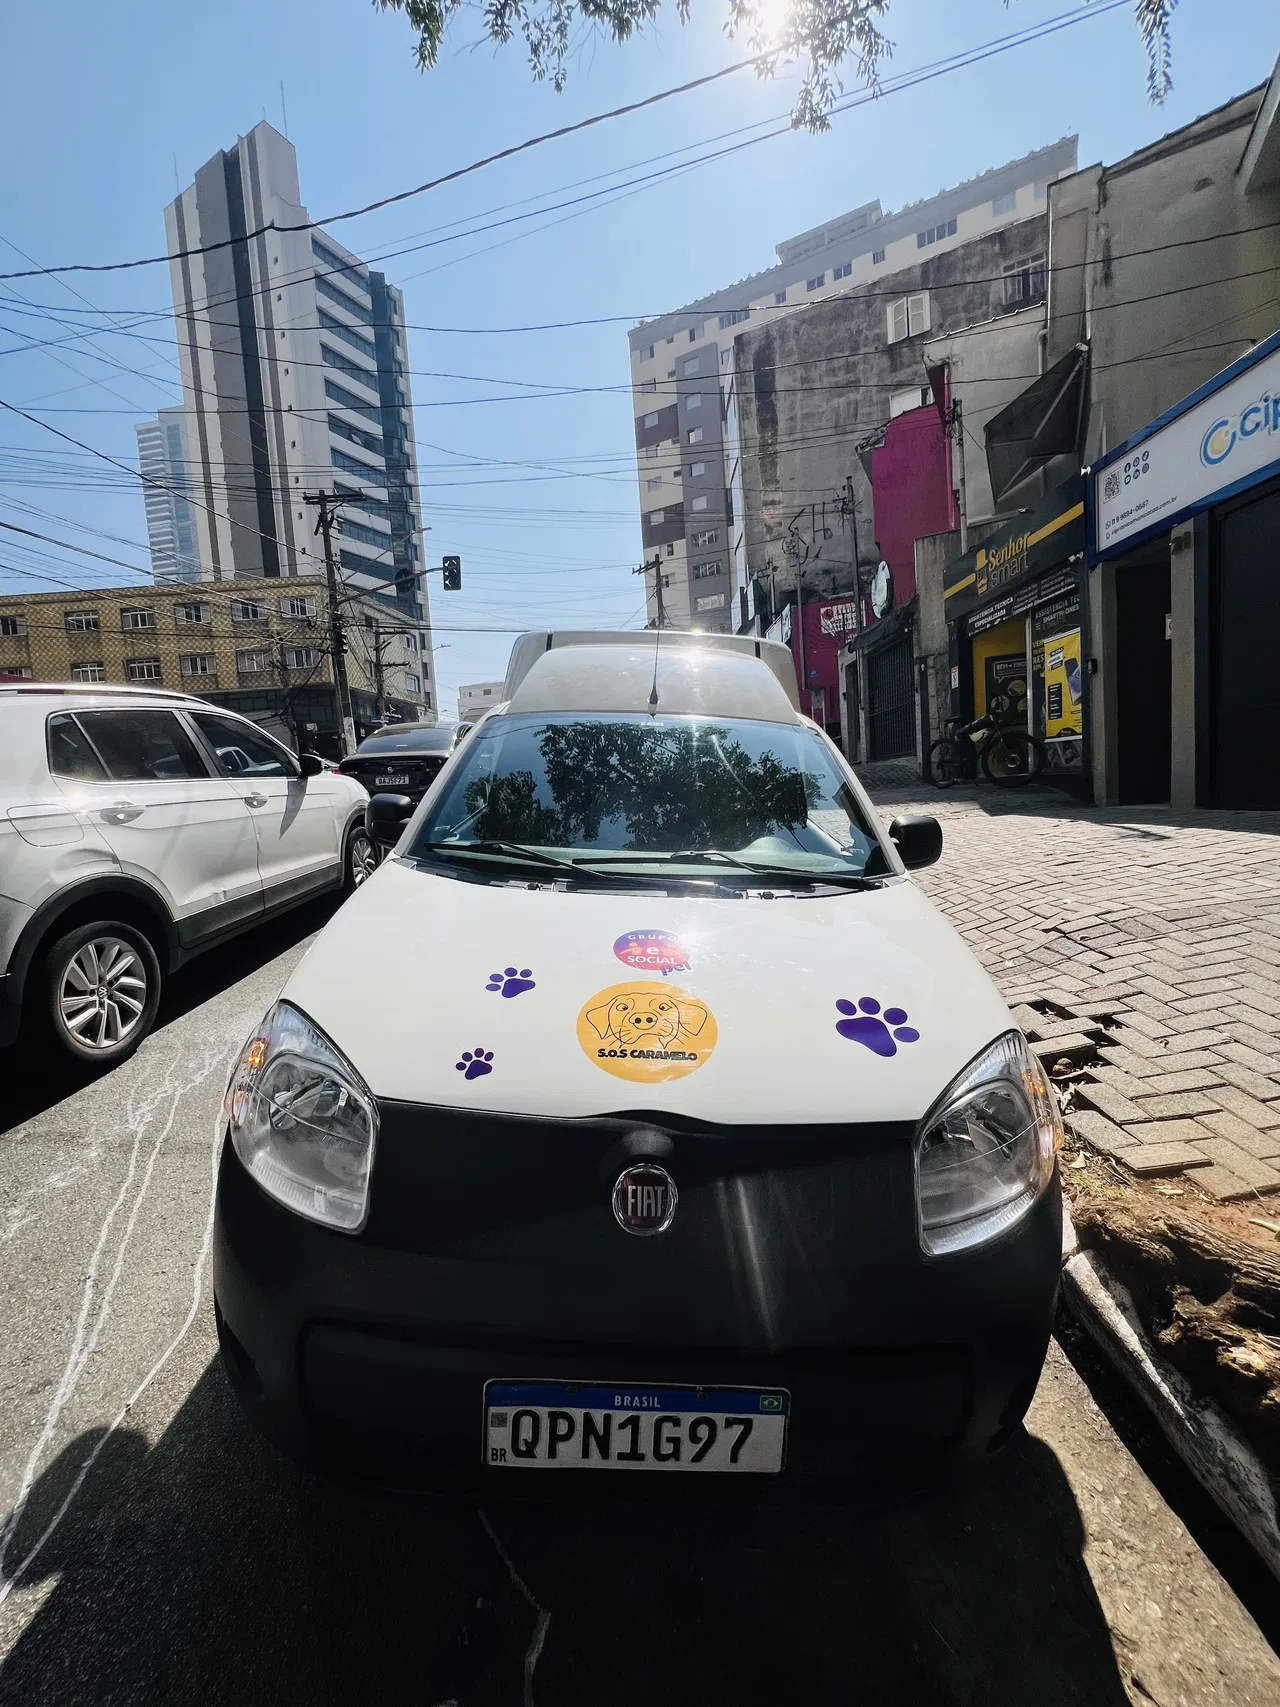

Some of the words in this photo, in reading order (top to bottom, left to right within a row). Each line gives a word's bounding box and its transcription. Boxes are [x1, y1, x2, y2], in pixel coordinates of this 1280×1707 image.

[988, 532, 1030, 571] Senhor
[991, 552, 1029, 588] smart
[627, 934, 677, 942] GRUPO
[627, 956, 679, 965] SOCIAL
[597, 1048, 628, 1059] S.O.S
[629, 1049, 698, 1061] CARAMELO
[627, 1185, 665, 1217] FIAT
[614, 1395, 662, 1408] BRASIL
[510, 1408, 753, 1464] QPN1G97
[490, 1448, 507, 1463] BR
